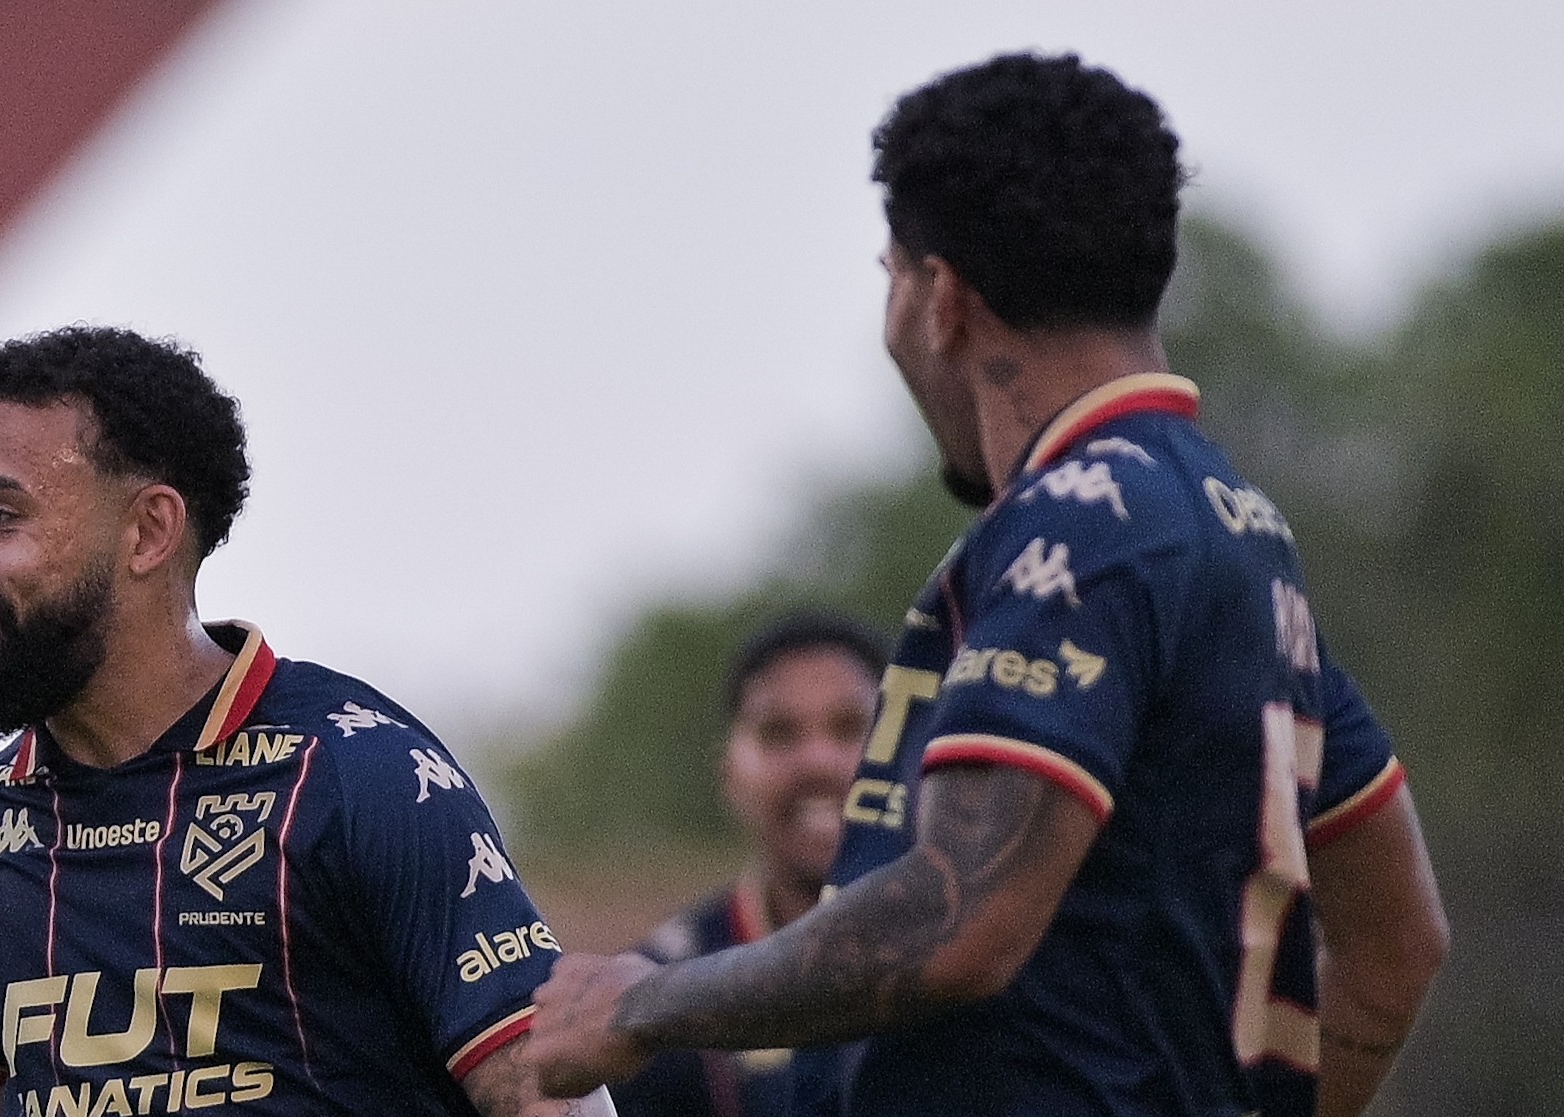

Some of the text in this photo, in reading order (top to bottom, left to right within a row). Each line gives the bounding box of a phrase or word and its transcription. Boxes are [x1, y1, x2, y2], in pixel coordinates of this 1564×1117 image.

[66, 817, 161, 850] Unoeste
[178, 911, 267, 926] PRUDENTE
[2, 963, 264, 1079] FUT
